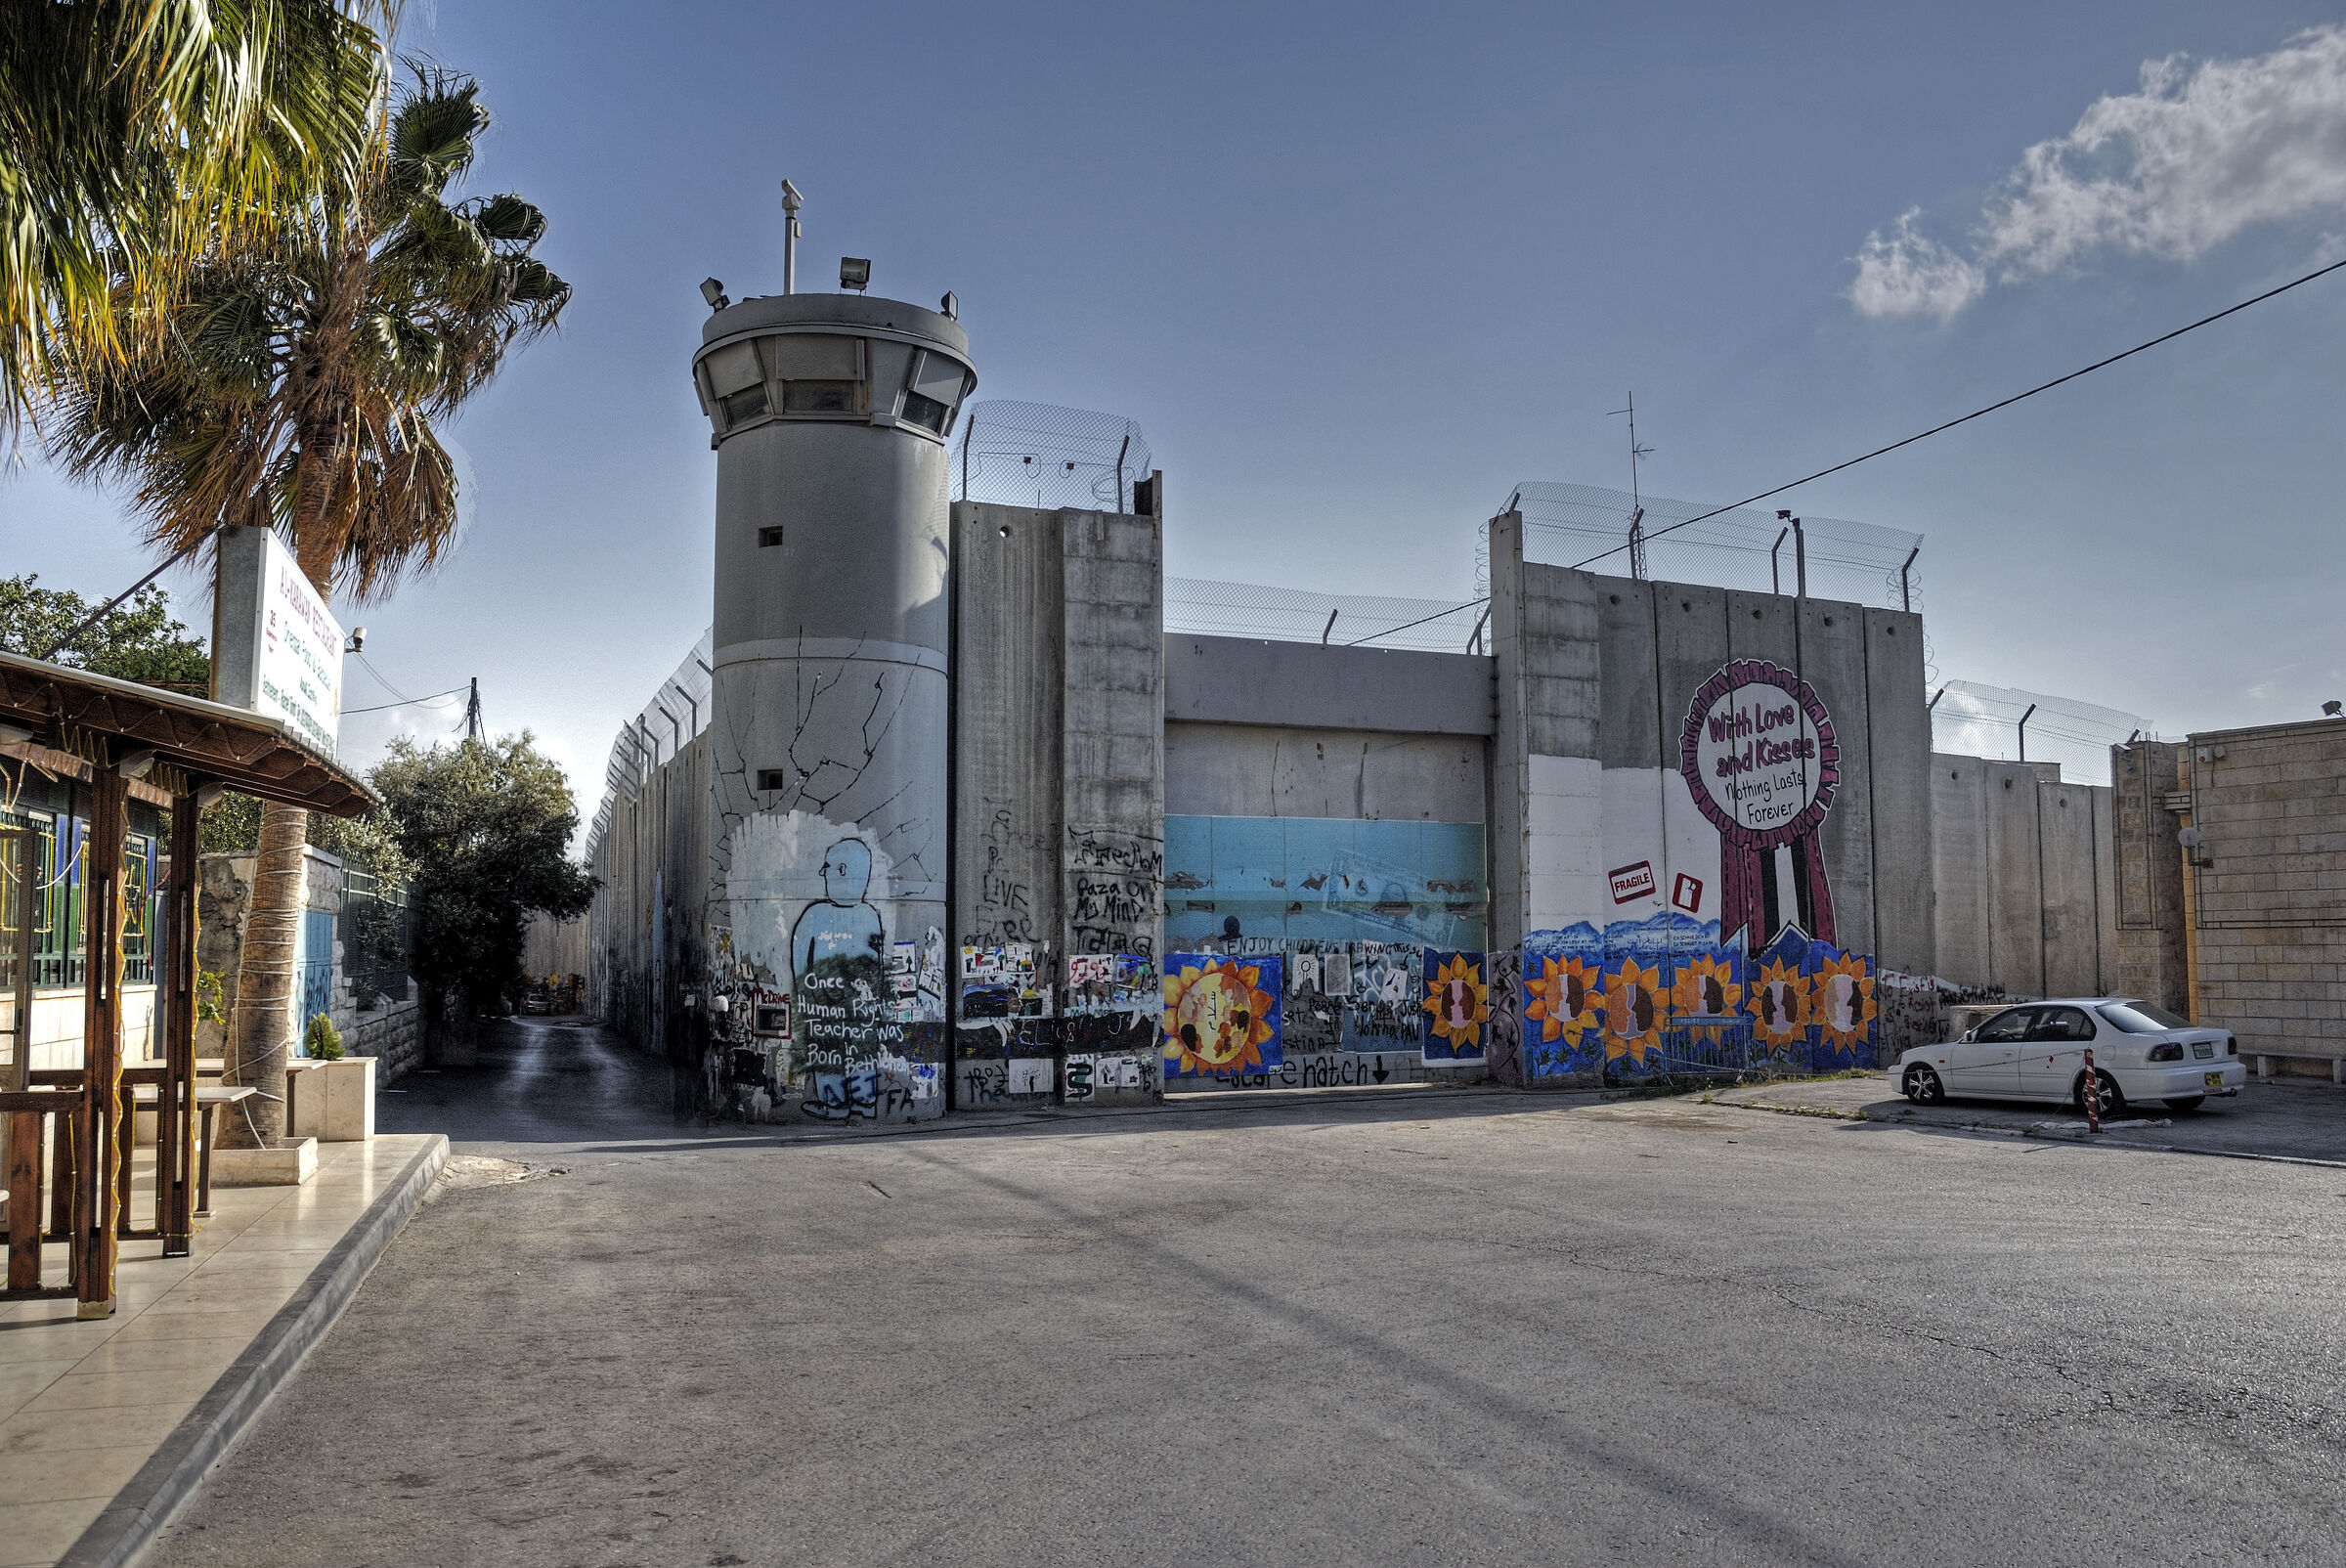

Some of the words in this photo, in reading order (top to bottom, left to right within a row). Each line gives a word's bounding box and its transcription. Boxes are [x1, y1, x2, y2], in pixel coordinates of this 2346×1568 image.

[1708, 706, 1752, 743] With
[1756, 703, 1795, 733] Love
[1716, 741, 1753, 777] and
[1756, 737, 1815, 768] Kisses
[1773, 768, 1805, 790] Lasts
[1747, 803, 1794, 824] Forever
[1614, 873, 1650, 893] FRAGILE
[1226, 936, 1274, 955] ENJOY
[804, 973, 845, 990] Once
[798, 993, 846, 1019] Human
[804, 1019, 873, 1040] Teacher
[806, 1043, 843, 1067] Born
[845, 1041, 858, 1056] in
[1303, 1056, 1368, 1089] hatch
